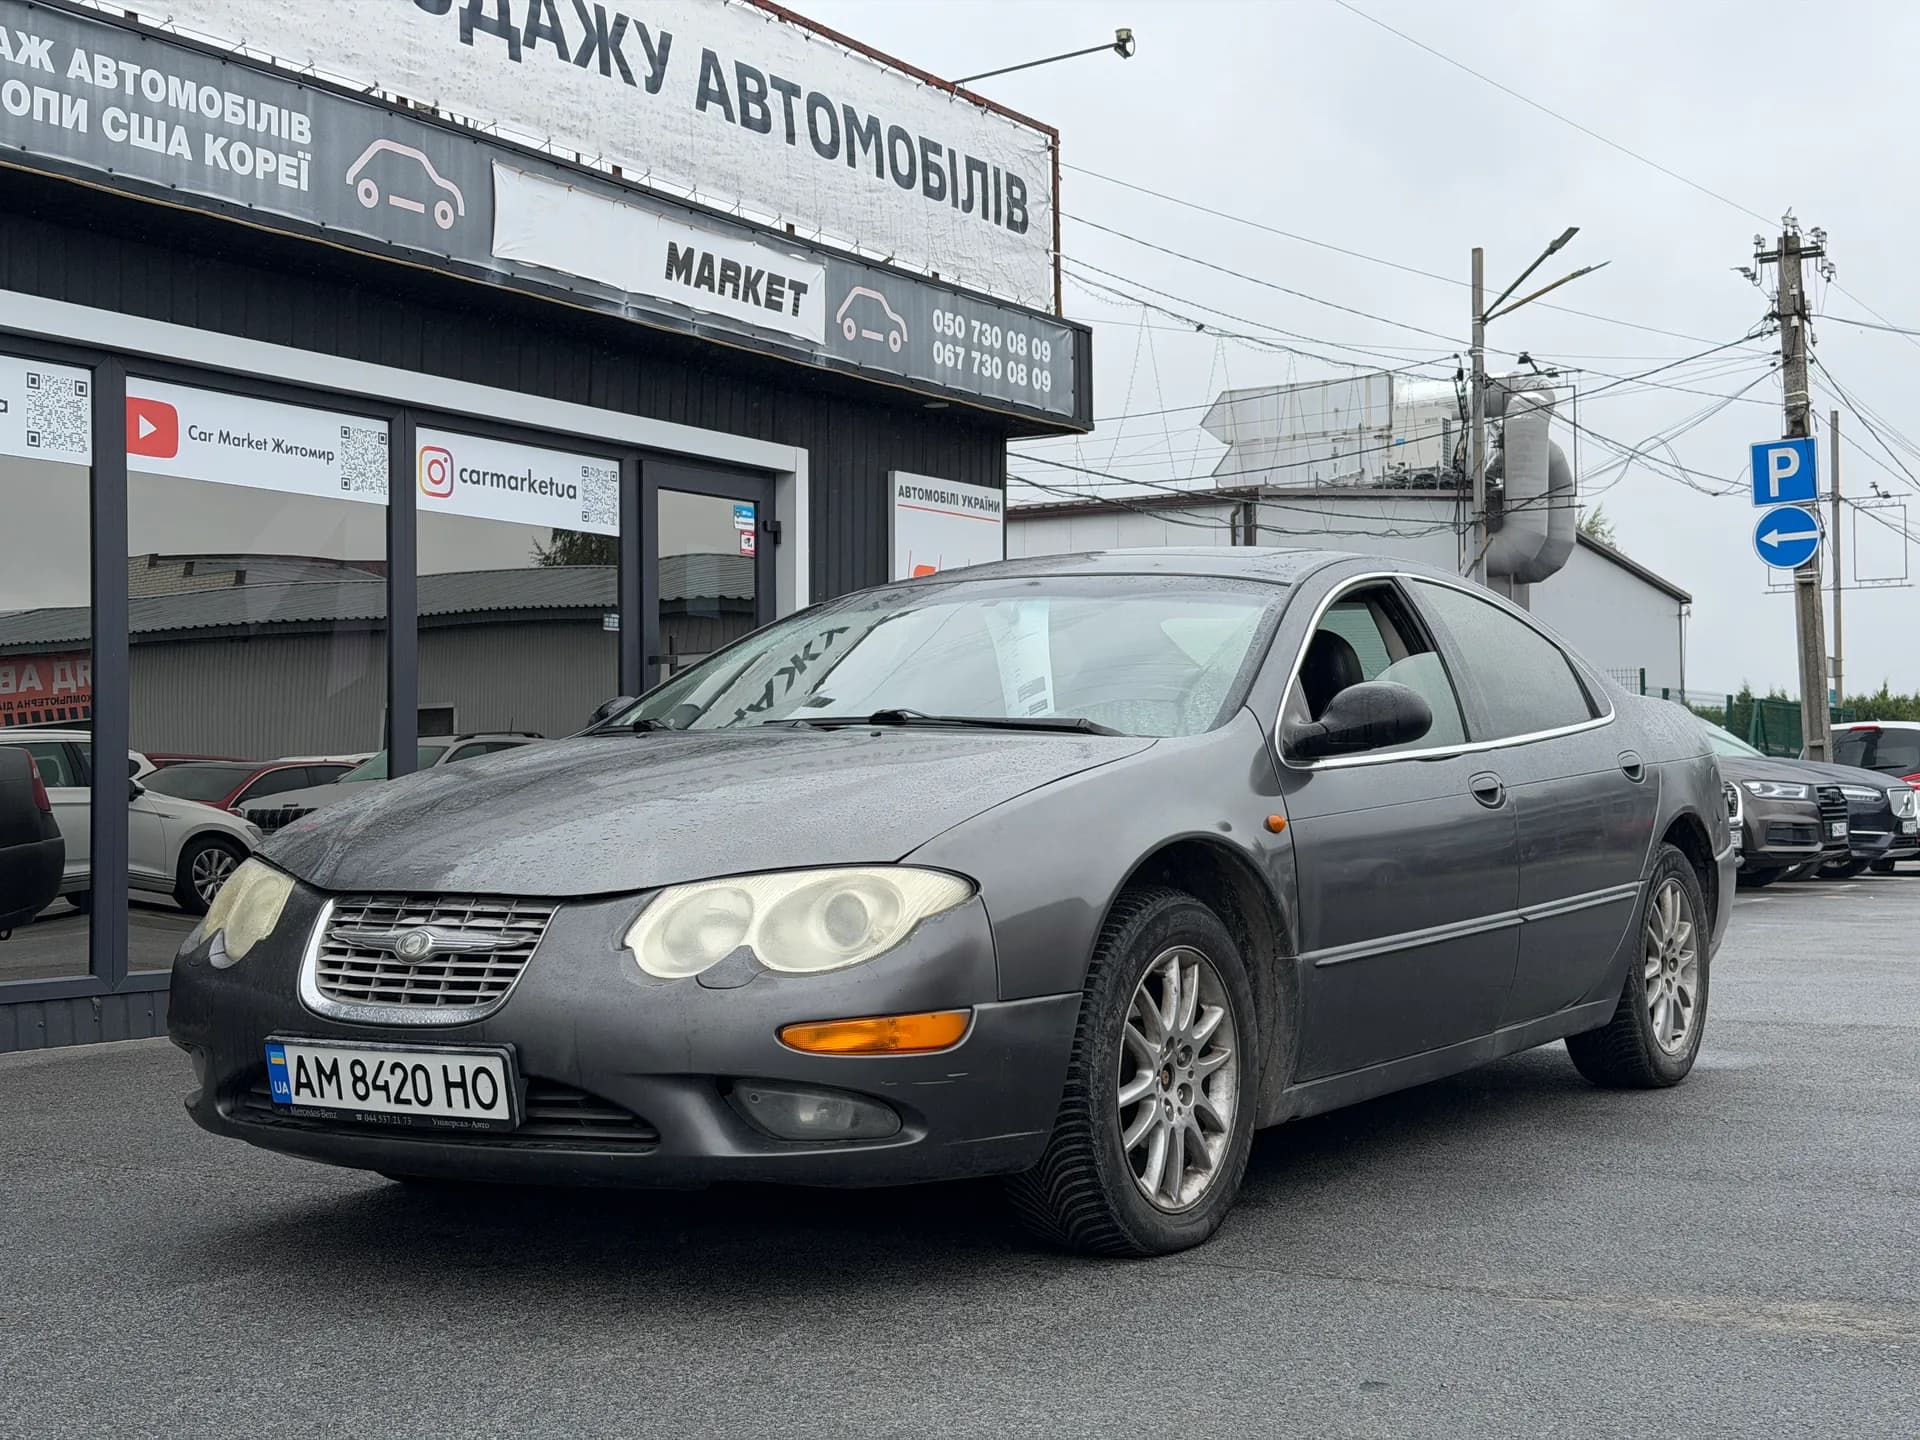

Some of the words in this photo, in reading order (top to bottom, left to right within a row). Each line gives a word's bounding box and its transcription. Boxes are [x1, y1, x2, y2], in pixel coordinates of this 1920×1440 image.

[66, 47, 312, 145] АВТОМОБІЛІВ
[413, 0, 673, 95] ДАЖУ
[695, 48, 1028, 235] АВТОМОБІЛІВ
[1, 79, 88, 133] ОПИ
[102, 106, 193, 161] США
[204, 132, 312, 191] КОРЕЇ
[665, 241, 808, 317] MARKET
[933, 309, 965, 339] 050
[971, 320, 1002, 349] 730
[1007, 330, 1027, 356] 08
[1032, 338, 1051, 363] 09
[933, 341, 965, 370] 067
[971, 351, 1002, 379] 730
[1007, 361, 1027, 386] 08
[1032, 368, 1051, 392] 09
[188, 425, 214, 443] Car
[218, 430, 268, 451] Market
[272, 438, 335, 464] Житомир
[459, 468, 577, 500] carmarketua
[1768, 448, 1800, 497] P
[898, 485, 959, 506] АВТОМОБІЛІ
[961, 494, 1000, 513] УКРАЇНИ
[275, 1080, 290, 1095] UA
[295, 1055, 343, 1100] AM
[350, 1059, 433, 1107] 8420
[442, 1065, 498, 1110] HO
